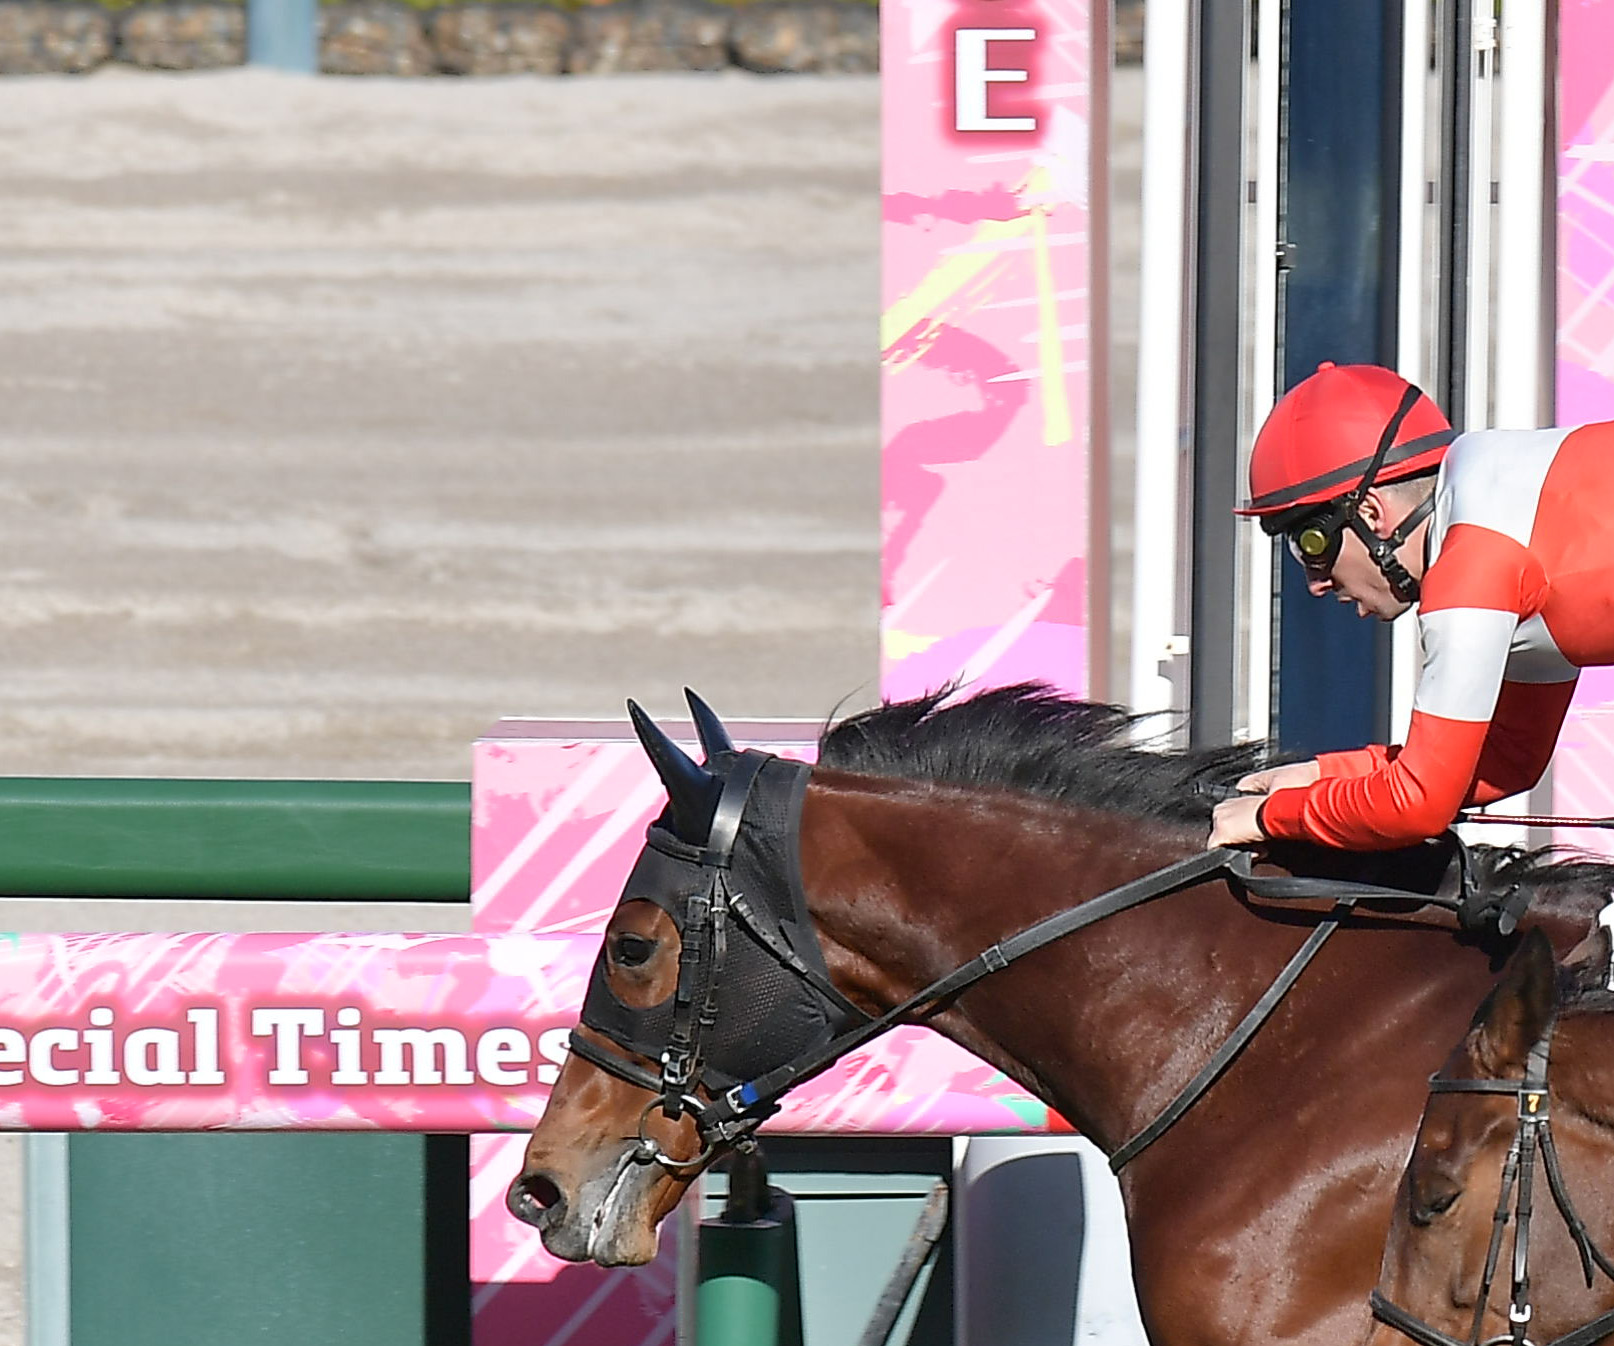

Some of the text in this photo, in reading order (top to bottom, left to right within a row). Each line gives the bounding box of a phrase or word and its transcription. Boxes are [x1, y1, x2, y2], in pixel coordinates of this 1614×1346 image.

[954, 27, 1038, 132] E
[251, 1007, 573, 1086] Times
[1527, 1093, 1541, 1114] 7
